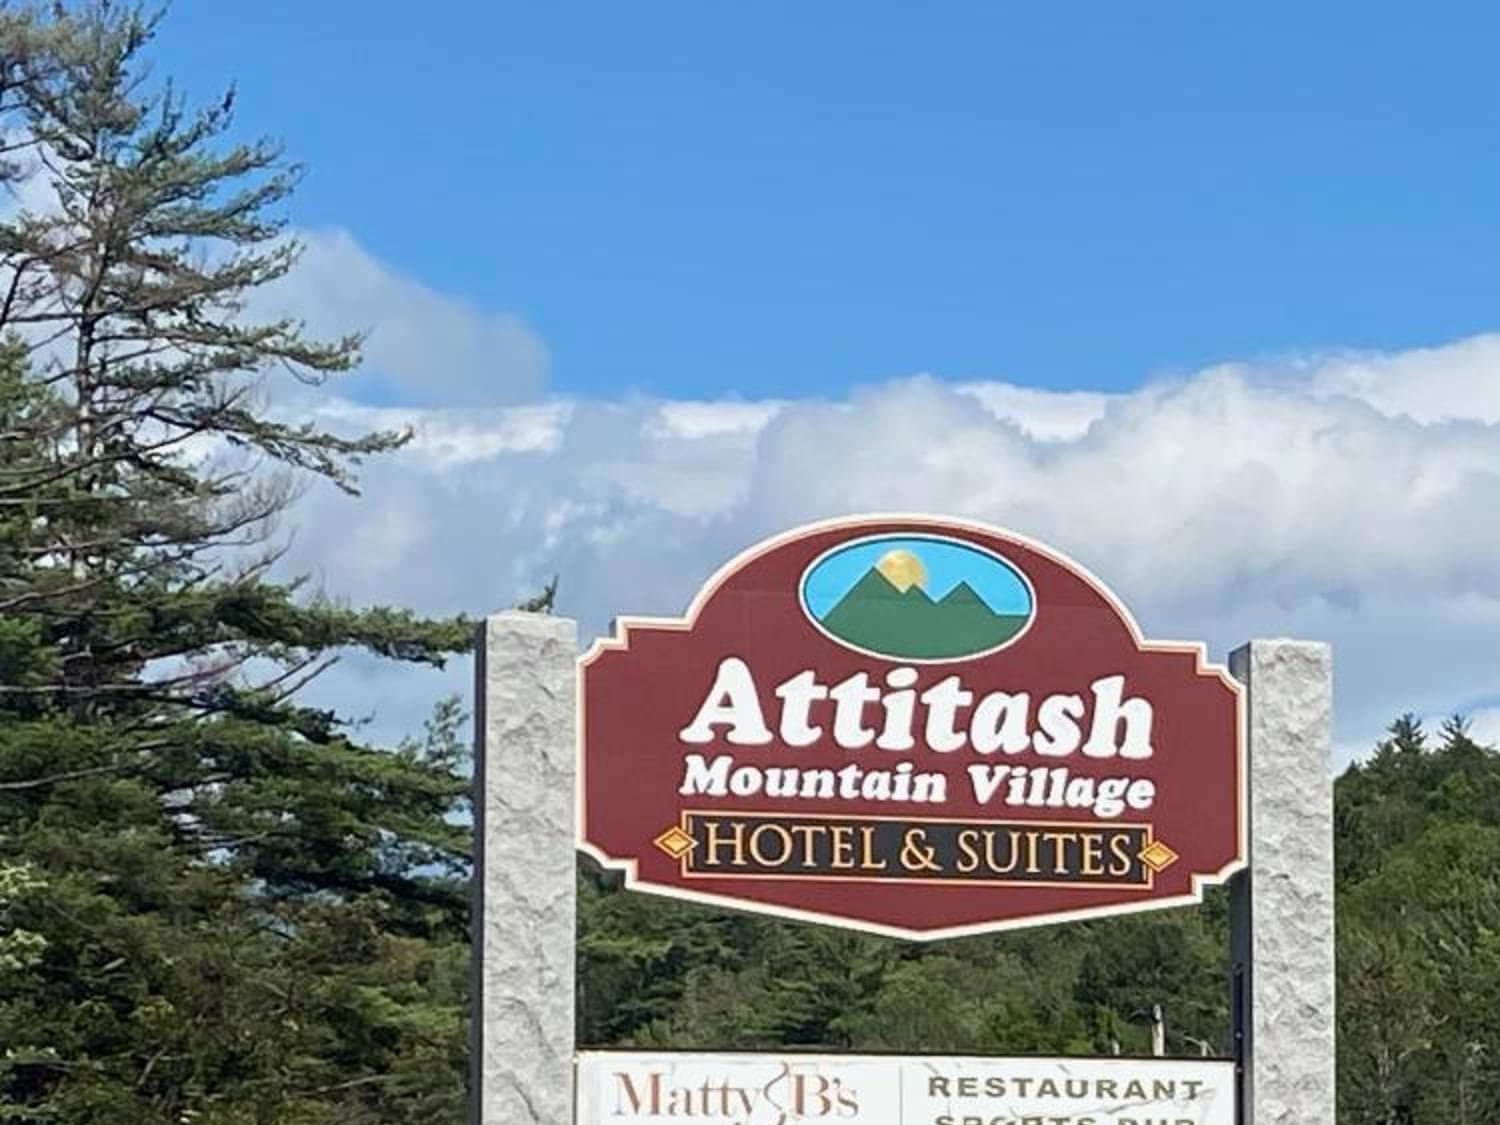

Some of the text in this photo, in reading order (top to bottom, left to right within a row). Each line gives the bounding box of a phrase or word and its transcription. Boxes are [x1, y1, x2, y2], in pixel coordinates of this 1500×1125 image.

[679, 657, 1154, 758] Attitash
[679, 755, 1155, 818] Mountain Village
[704, 822, 1132, 876] HOTEL & SUITES
[791, 1073, 860, 1117] B's
[928, 1076, 1204, 1101] RESTAURANT
